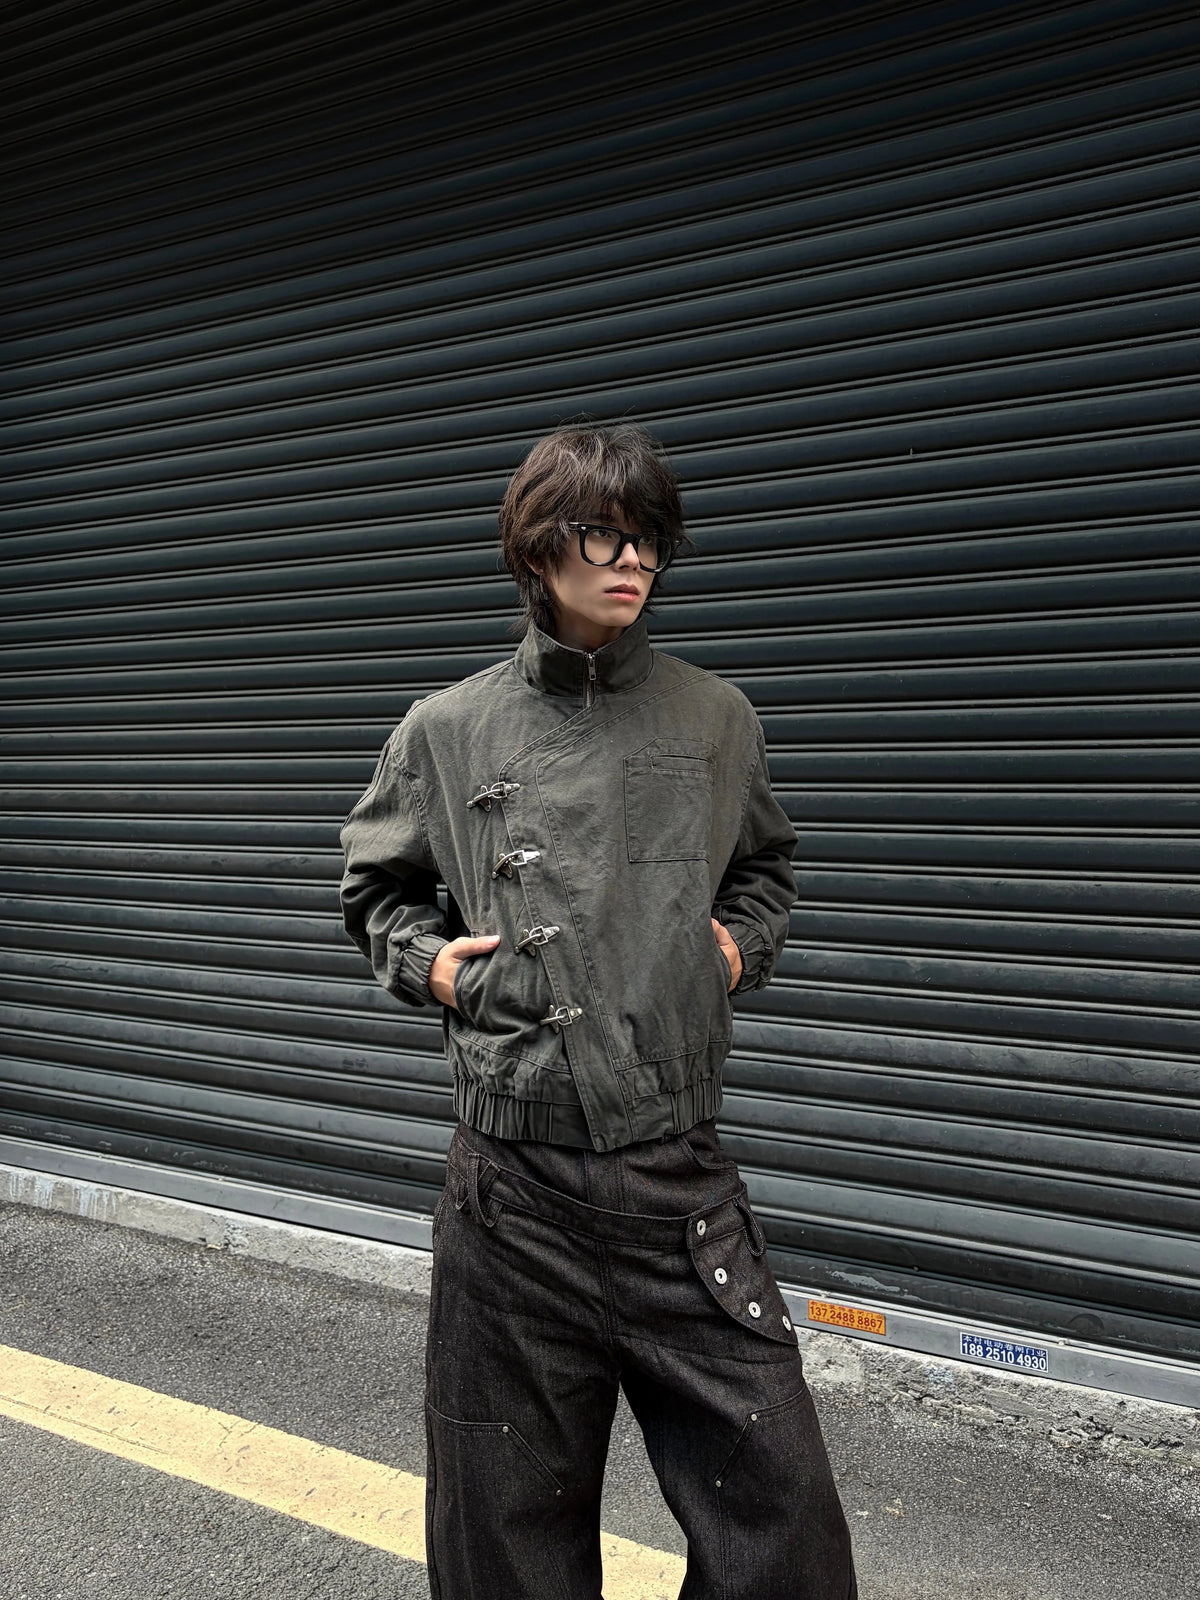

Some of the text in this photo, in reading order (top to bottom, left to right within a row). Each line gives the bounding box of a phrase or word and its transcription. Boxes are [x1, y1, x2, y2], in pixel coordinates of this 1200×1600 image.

[809, 1306, 827, 1317] 137
[830, 1310, 855, 1323] 2488
[857, 1316, 883, 1329] 8867
[963, 1342, 1046, 1370] 188 2510 4930
